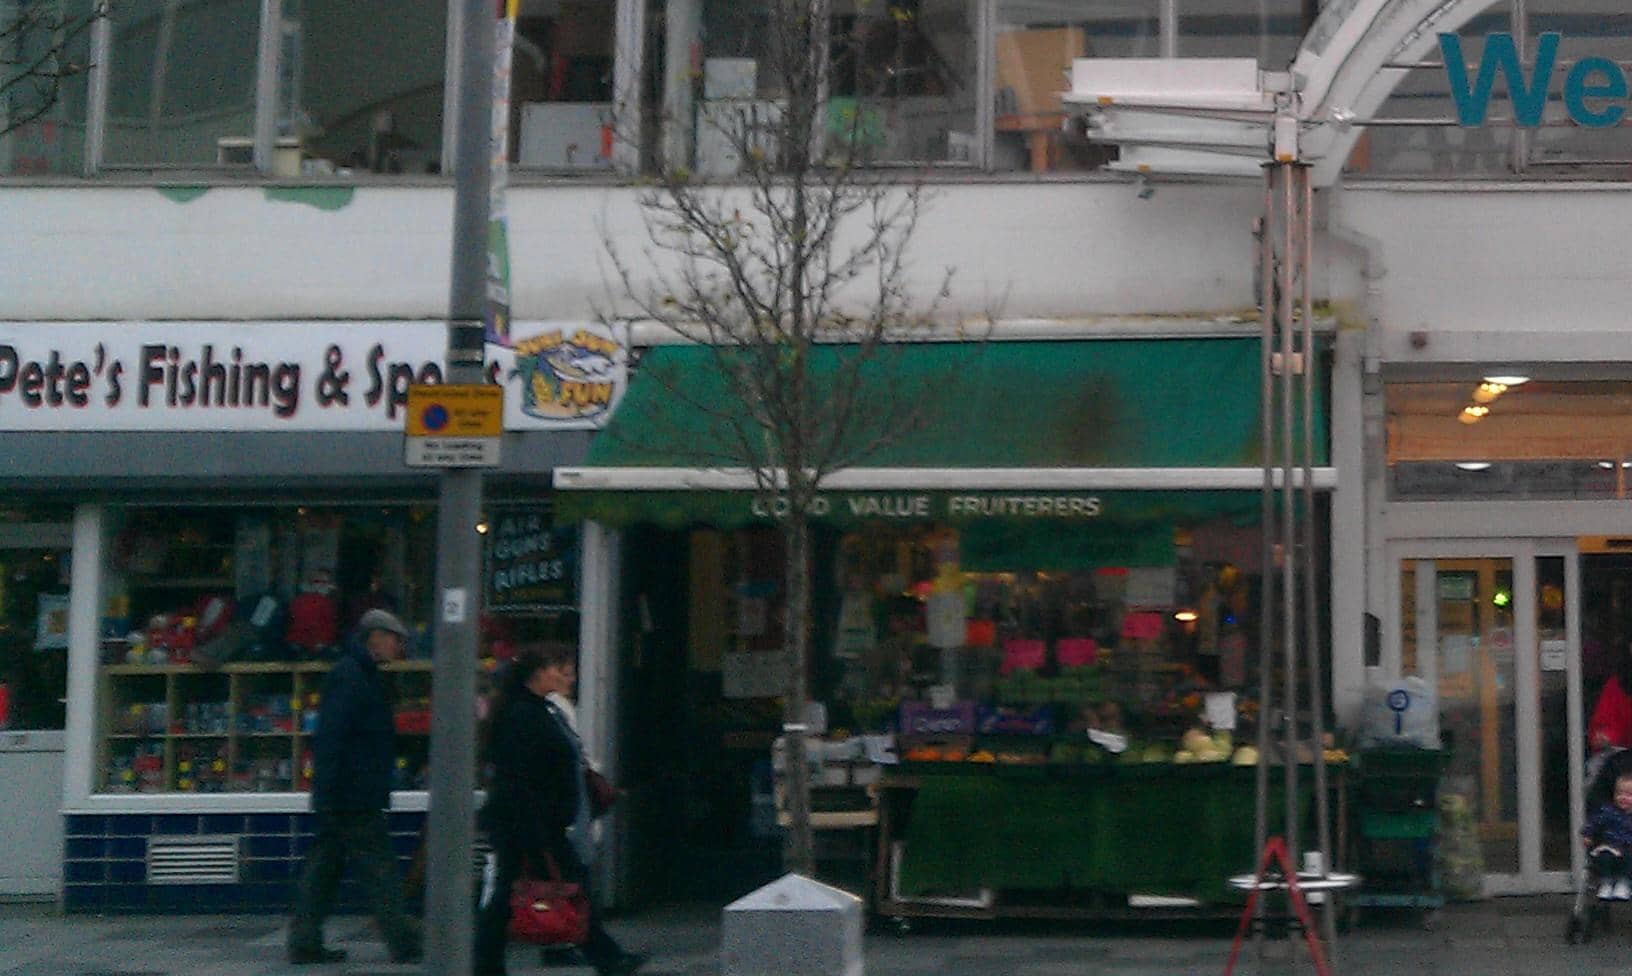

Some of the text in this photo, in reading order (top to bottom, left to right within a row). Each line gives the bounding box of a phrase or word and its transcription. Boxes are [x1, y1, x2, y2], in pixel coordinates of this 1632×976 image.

[0, 341, 124, 409] Pete's
[137, 342, 301, 418] Fishing
[315, 343, 350, 408] &
[560, 381, 613, 408] FUN
[848, 495, 930, 517] VALUE
[949, 495, 1101, 517] FRUITERERS
[493, 560, 564, 593] RIFLES
